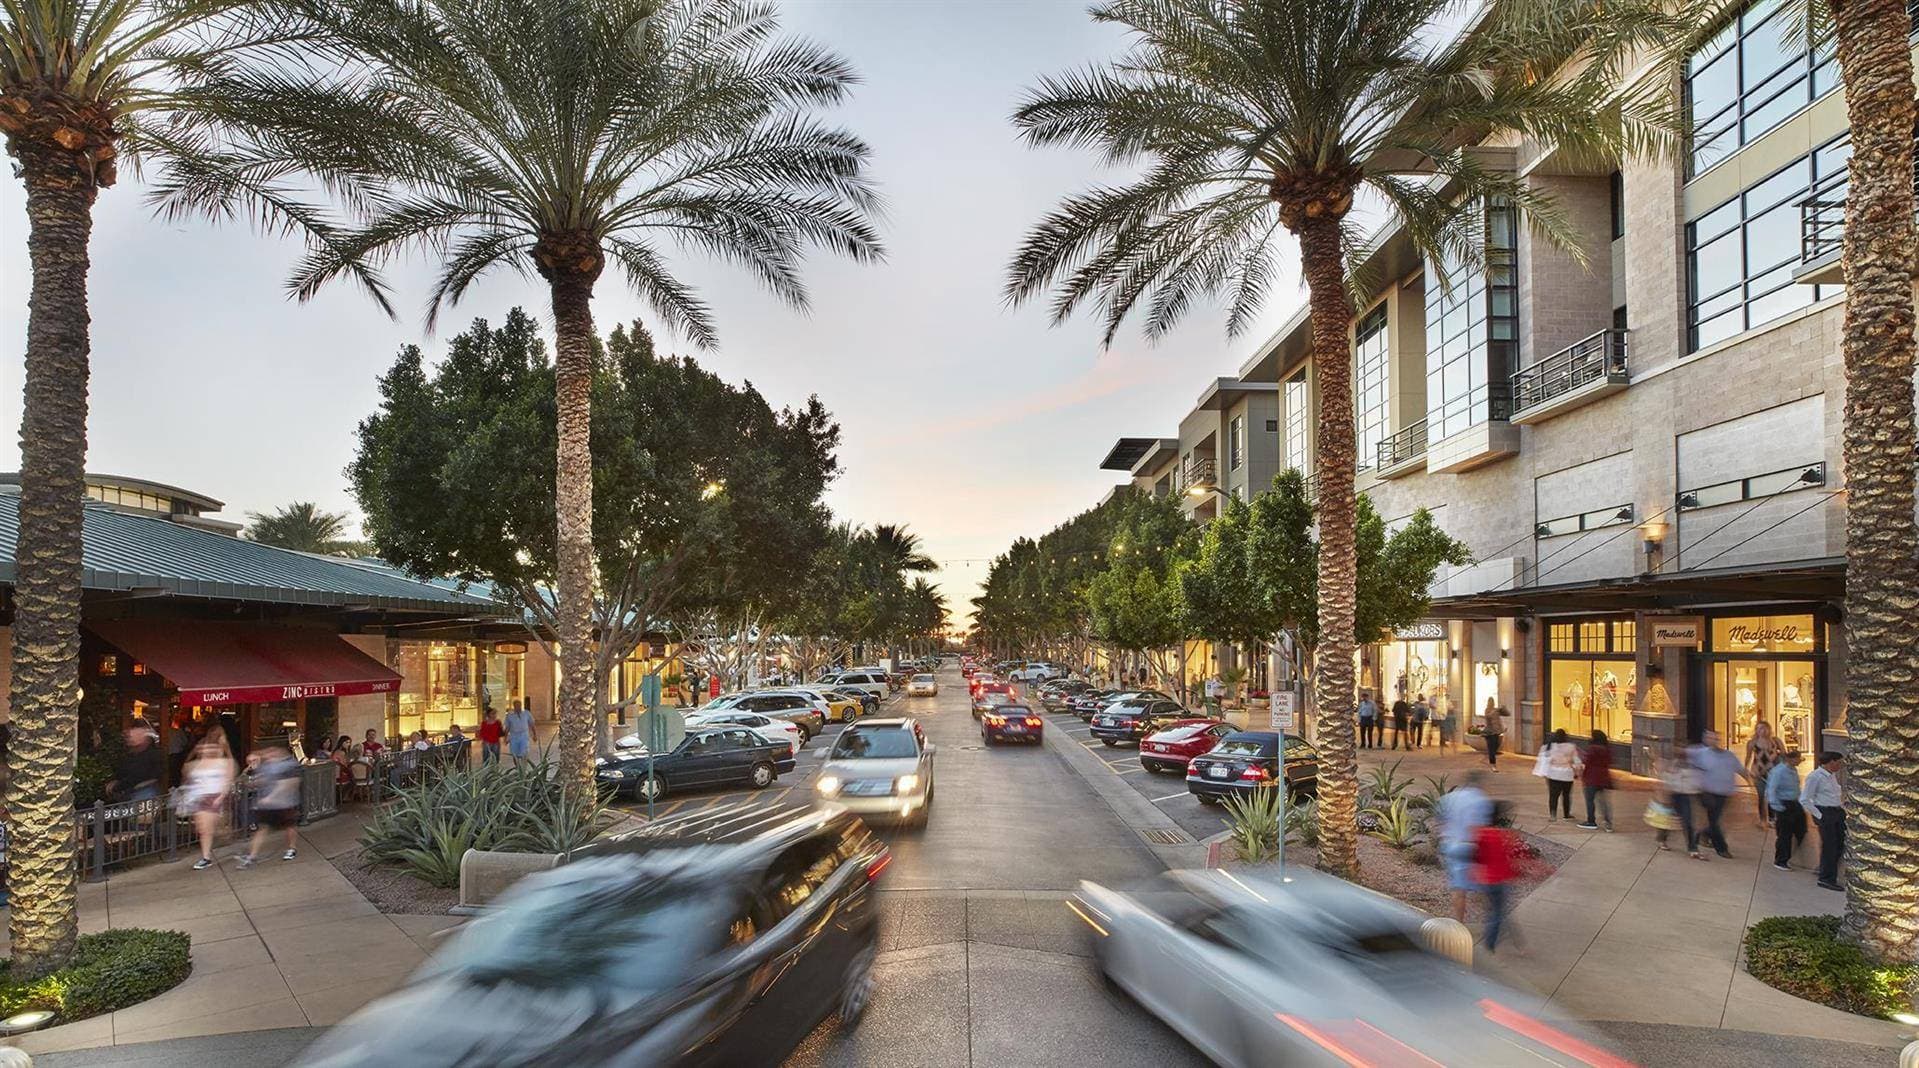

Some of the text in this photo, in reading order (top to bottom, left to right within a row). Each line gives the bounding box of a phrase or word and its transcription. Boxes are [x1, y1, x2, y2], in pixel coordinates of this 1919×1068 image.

[1656, 629, 1695, 640] Madewell
[1729, 625, 1798, 644] Madewell
[203, 692, 230, 702] LUNCH
[282, 686, 335, 699] ZINC BISTRO
